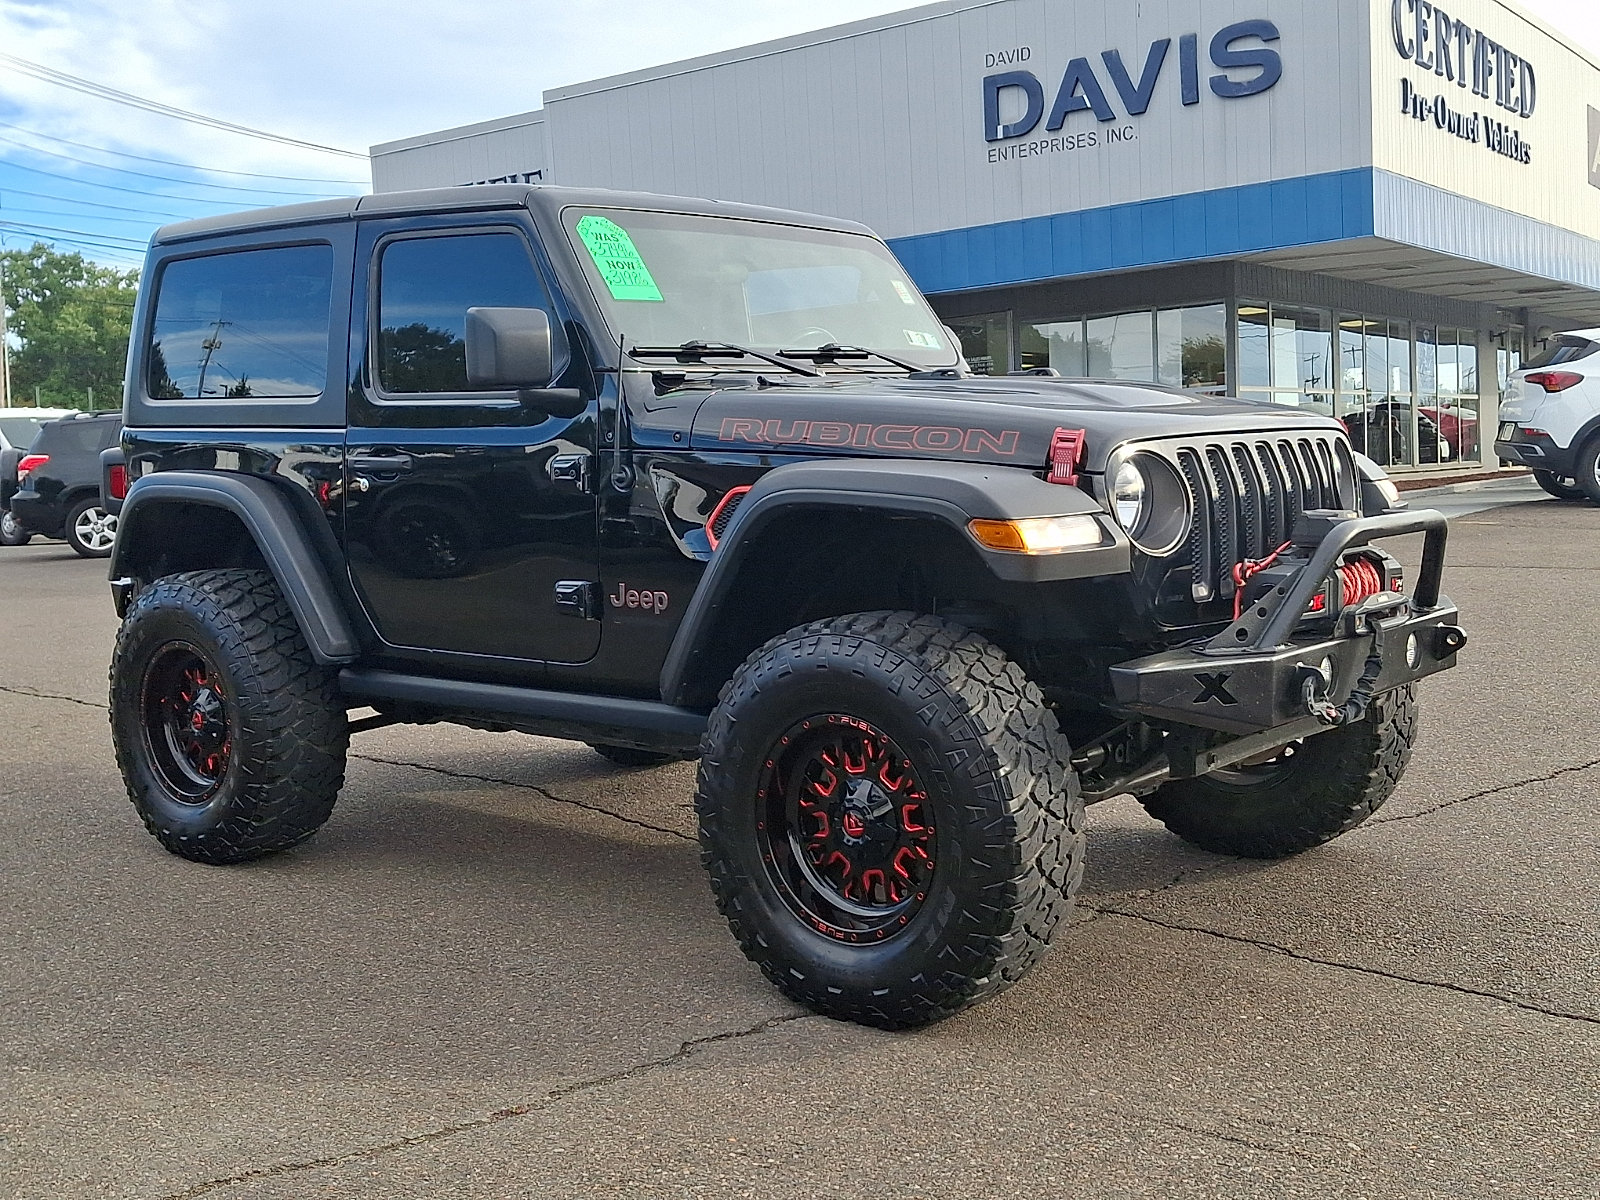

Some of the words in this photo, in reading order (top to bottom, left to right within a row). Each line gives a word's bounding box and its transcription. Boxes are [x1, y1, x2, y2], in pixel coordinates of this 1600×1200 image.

[984, 46, 1032, 69] DAVID
[1391, 0, 1536, 119] CERTIFIED
[982, 18, 1283, 142] DAVIS
[1400, 77, 1480, 143] Pre-Owned
[1482, 115, 1532, 164] Vehicles
[987, 131, 1101, 164] ENTERPRISES,
[1105, 125, 1139, 144] INC.
[590, 232, 620, 242] WAS
[606, 260, 636, 270] NOW
[718, 417, 1021, 456] RUBICON
[609, 582, 669, 615] Jeep
[840, 716, 877, 736] FUEL
